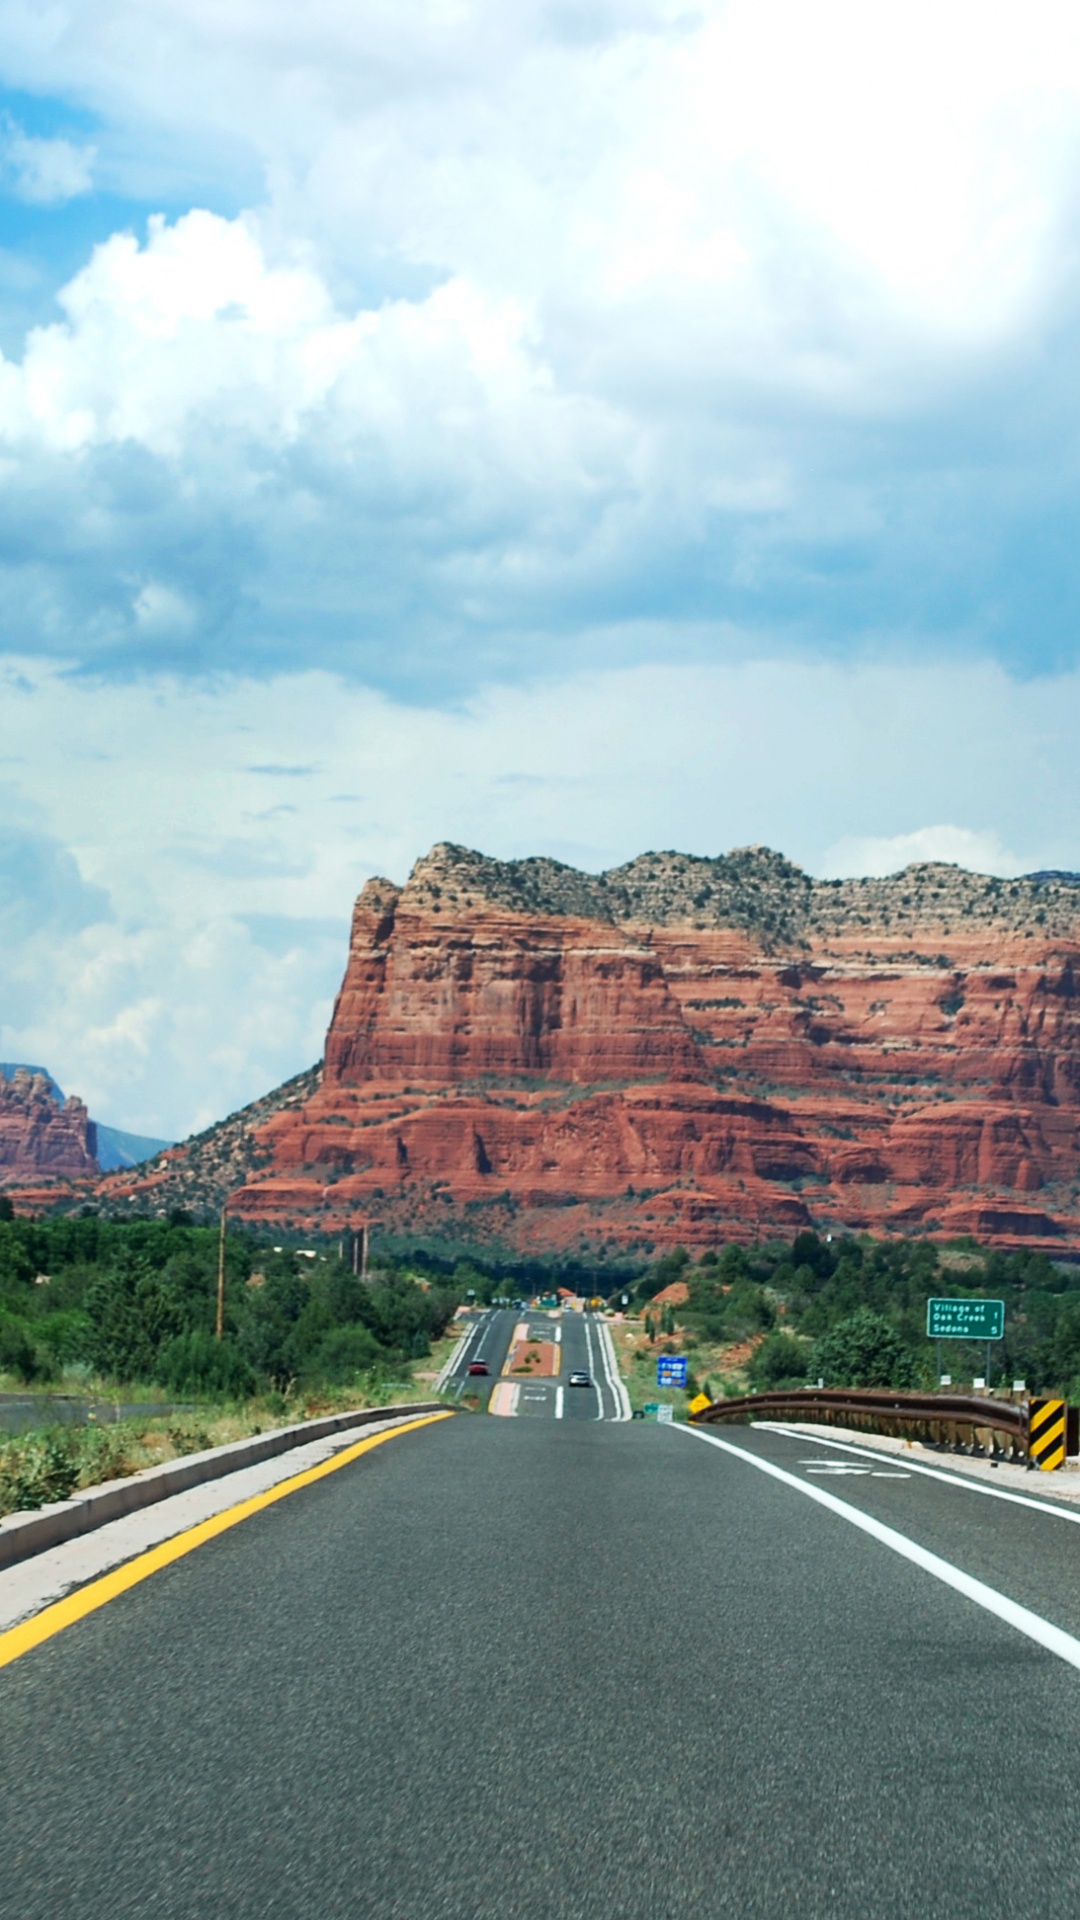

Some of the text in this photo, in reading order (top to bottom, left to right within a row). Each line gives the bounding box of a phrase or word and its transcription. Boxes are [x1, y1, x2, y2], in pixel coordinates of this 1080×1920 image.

[933, 1304, 985, 1314] Village of
[933, 1312, 985, 1322] Oak Creek
[933, 1323, 969, 1333] Sedona
